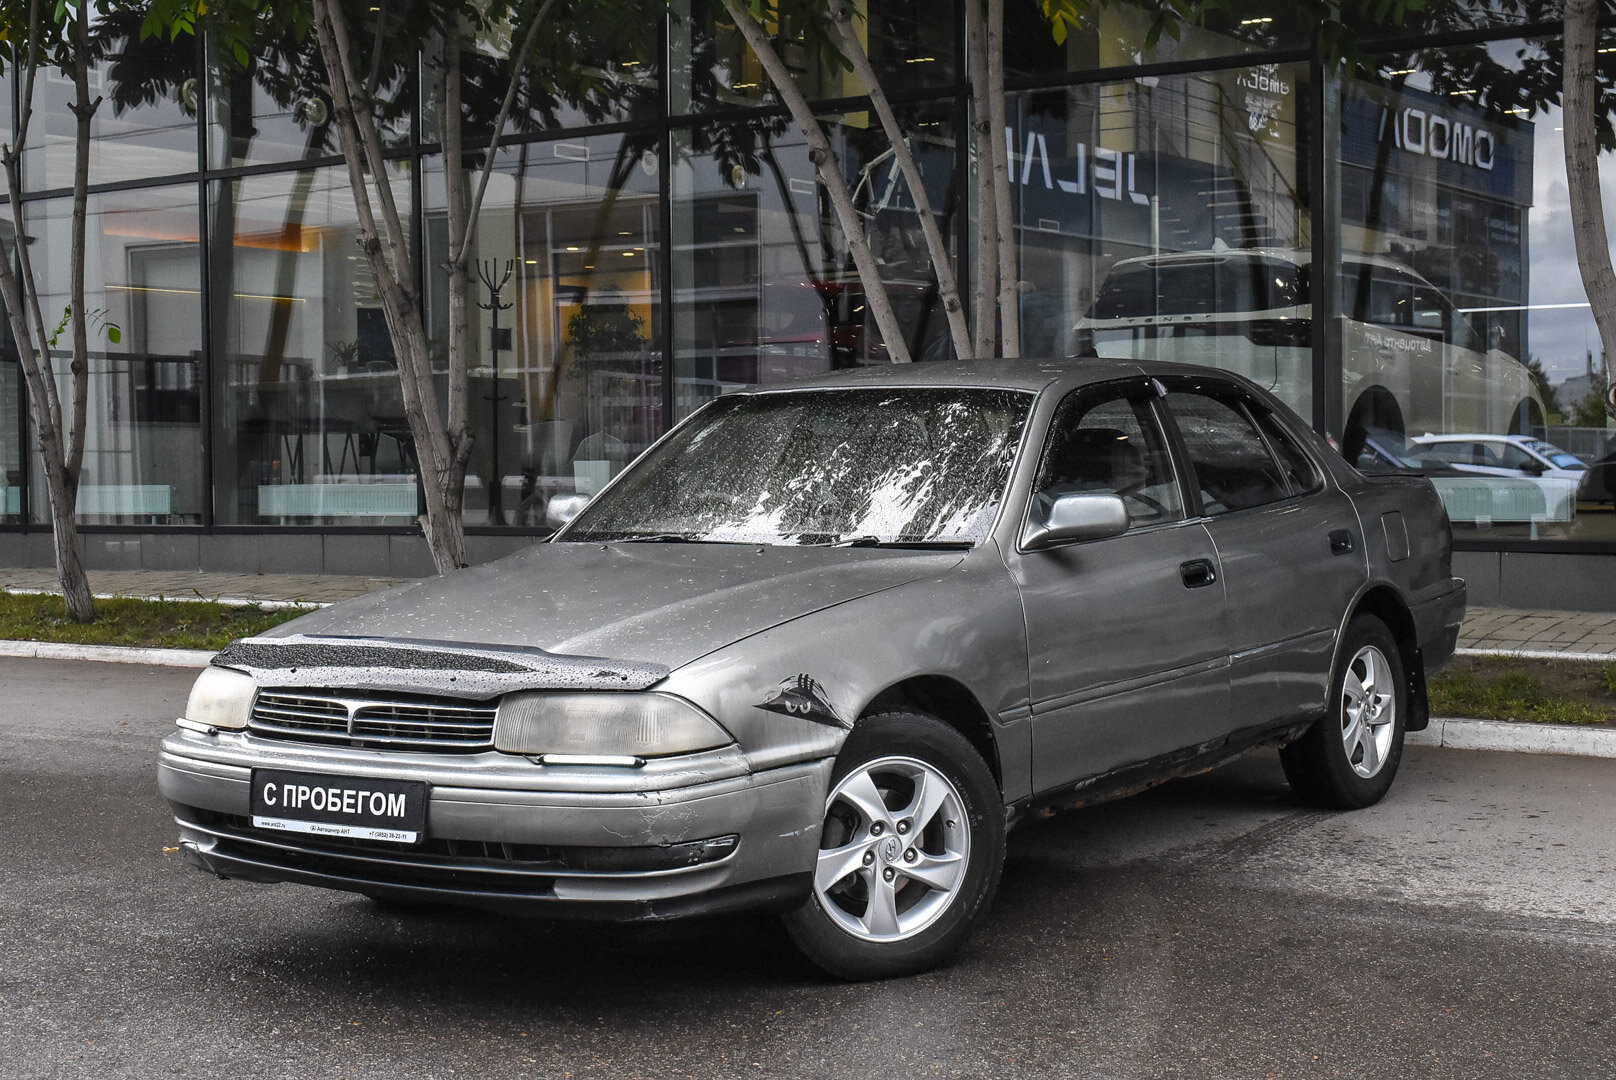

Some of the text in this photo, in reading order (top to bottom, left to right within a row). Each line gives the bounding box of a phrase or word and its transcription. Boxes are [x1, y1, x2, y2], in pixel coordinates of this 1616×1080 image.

[263, 782, 406, 818] С ПРОБЕГОМ
[317, 826, 340, 835] Автоцентр
